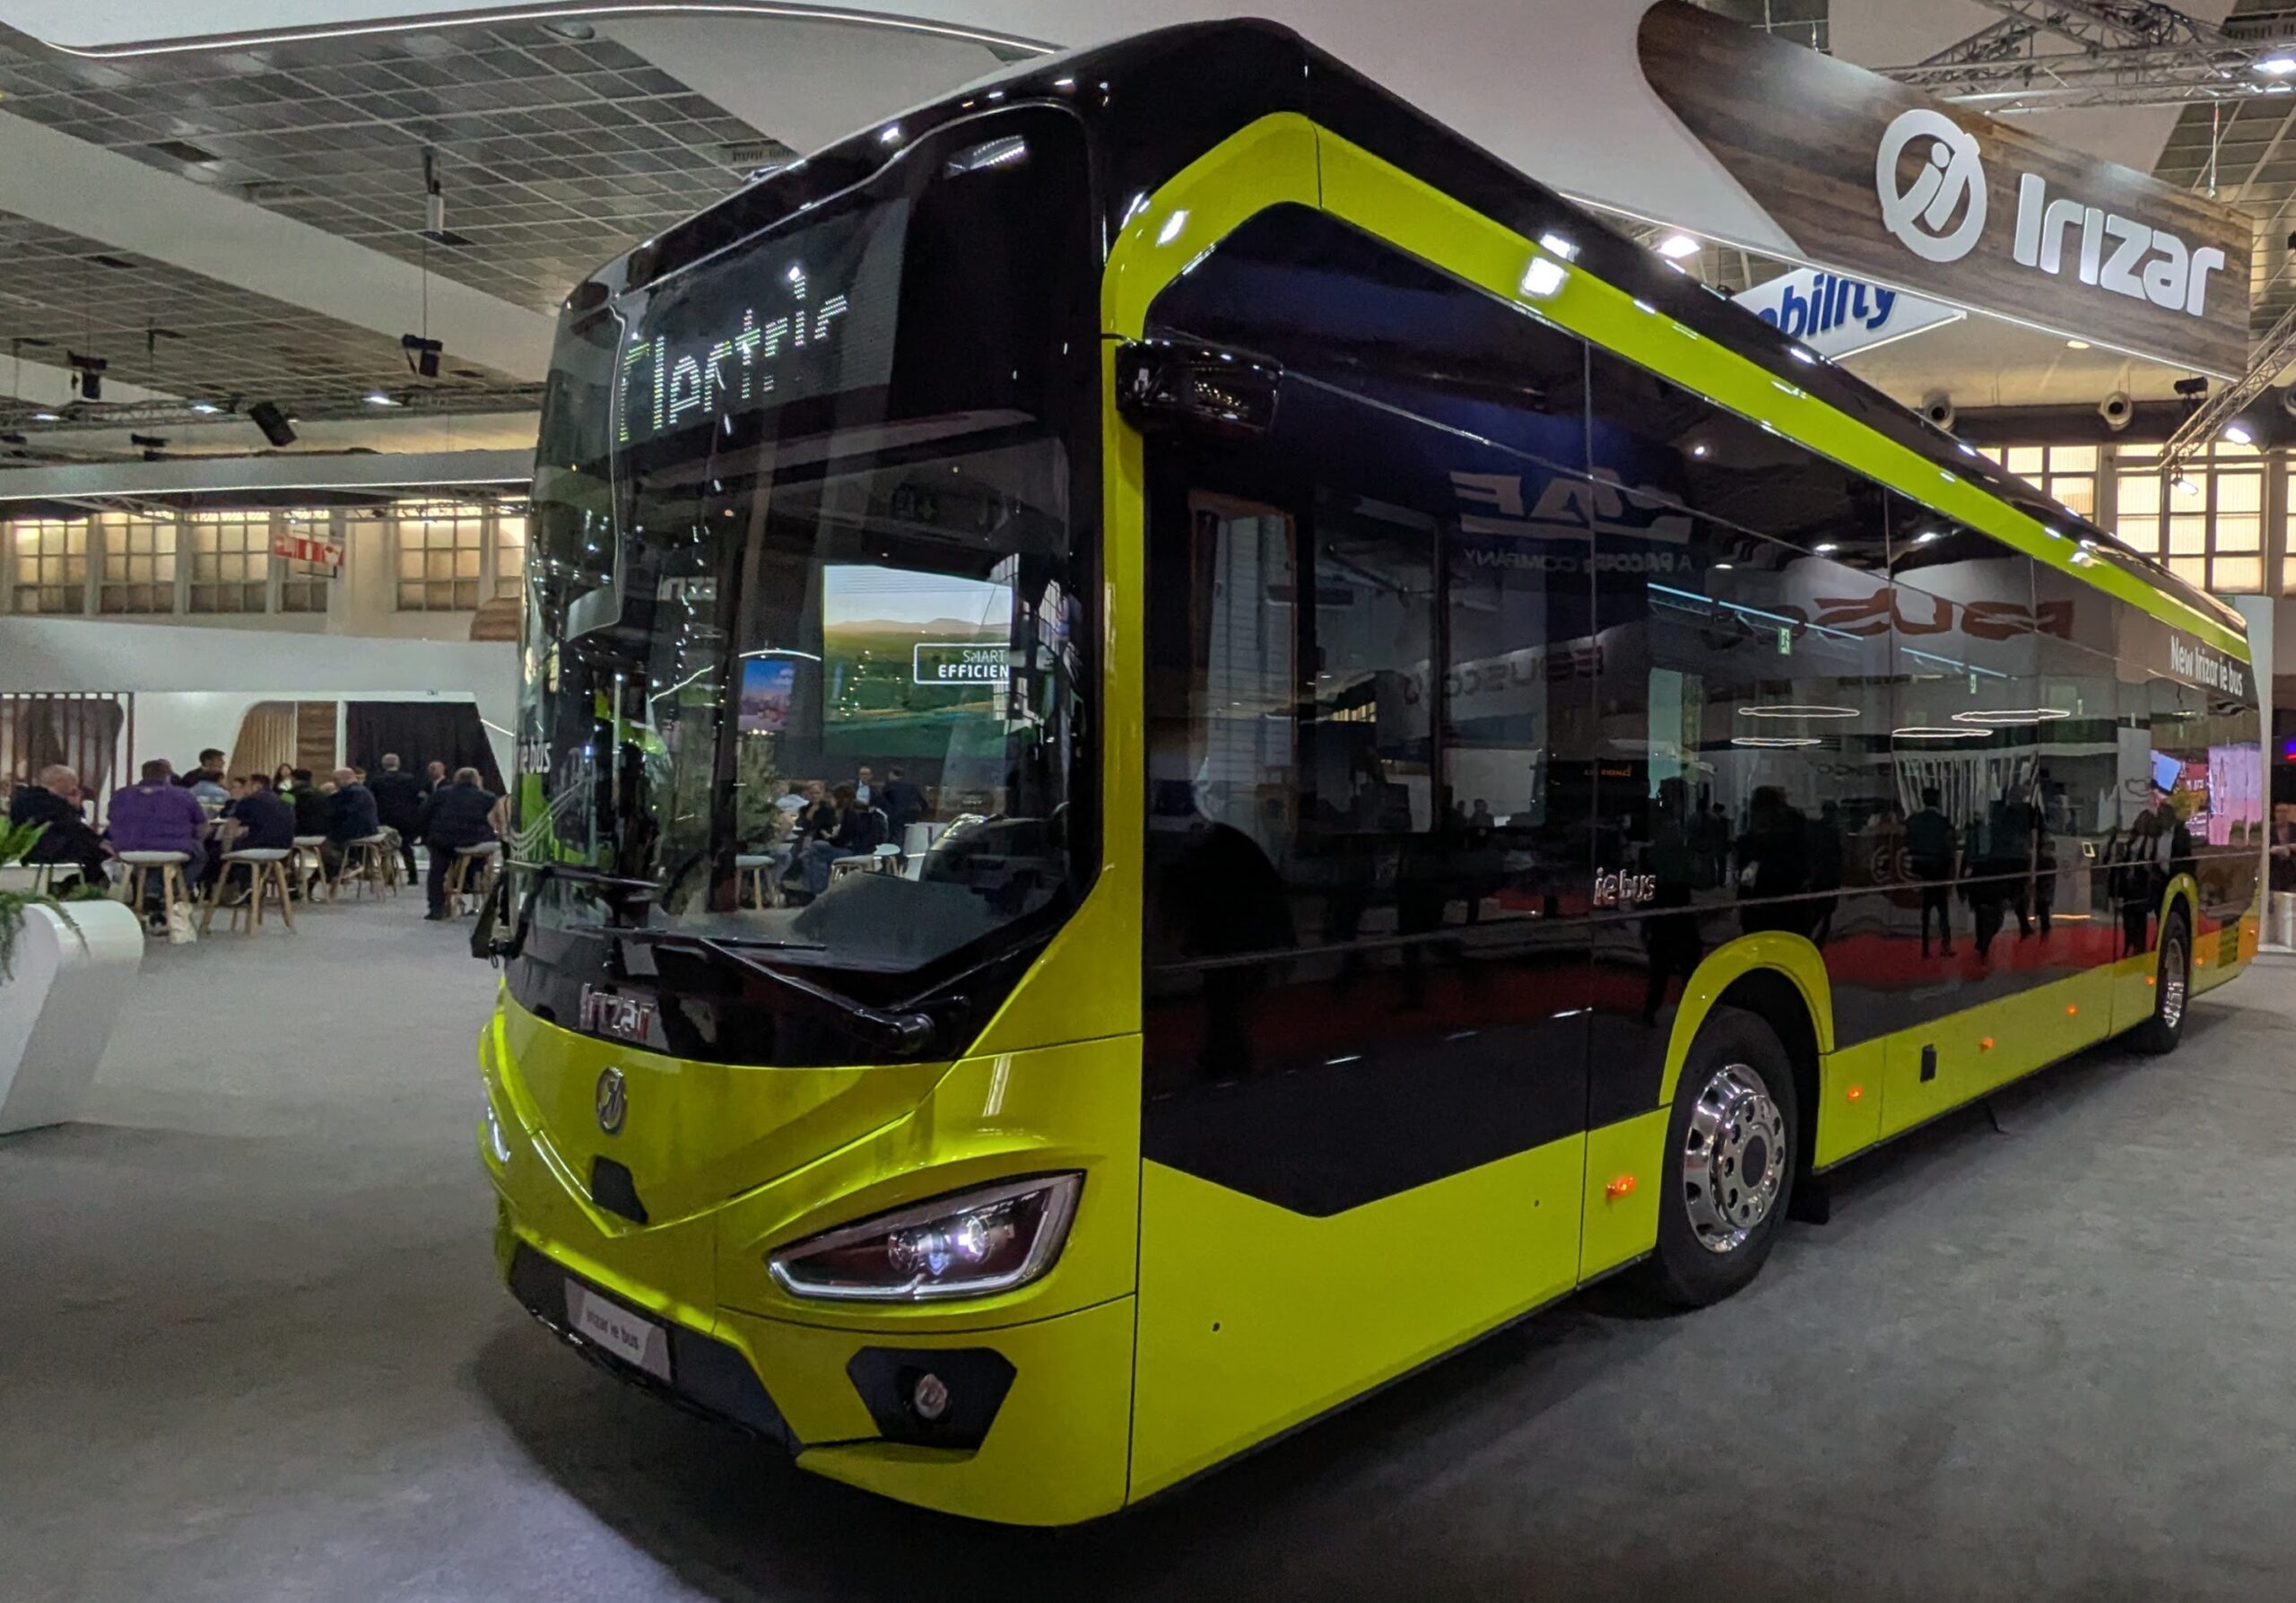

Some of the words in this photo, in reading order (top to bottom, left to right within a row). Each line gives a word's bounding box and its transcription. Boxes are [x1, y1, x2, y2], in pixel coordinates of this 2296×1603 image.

[2013, 172, 2225, 317] Irizar
[2170, 634, 2193, 677] New
[2195, 646, 2218, 687] Irizar
[2219, 656, 2228, 691] ie
[2229, 660, 2242, 696] bus
[1593, 867, 1618, 906] ie
[1619, 868, 1657, 902] bus
